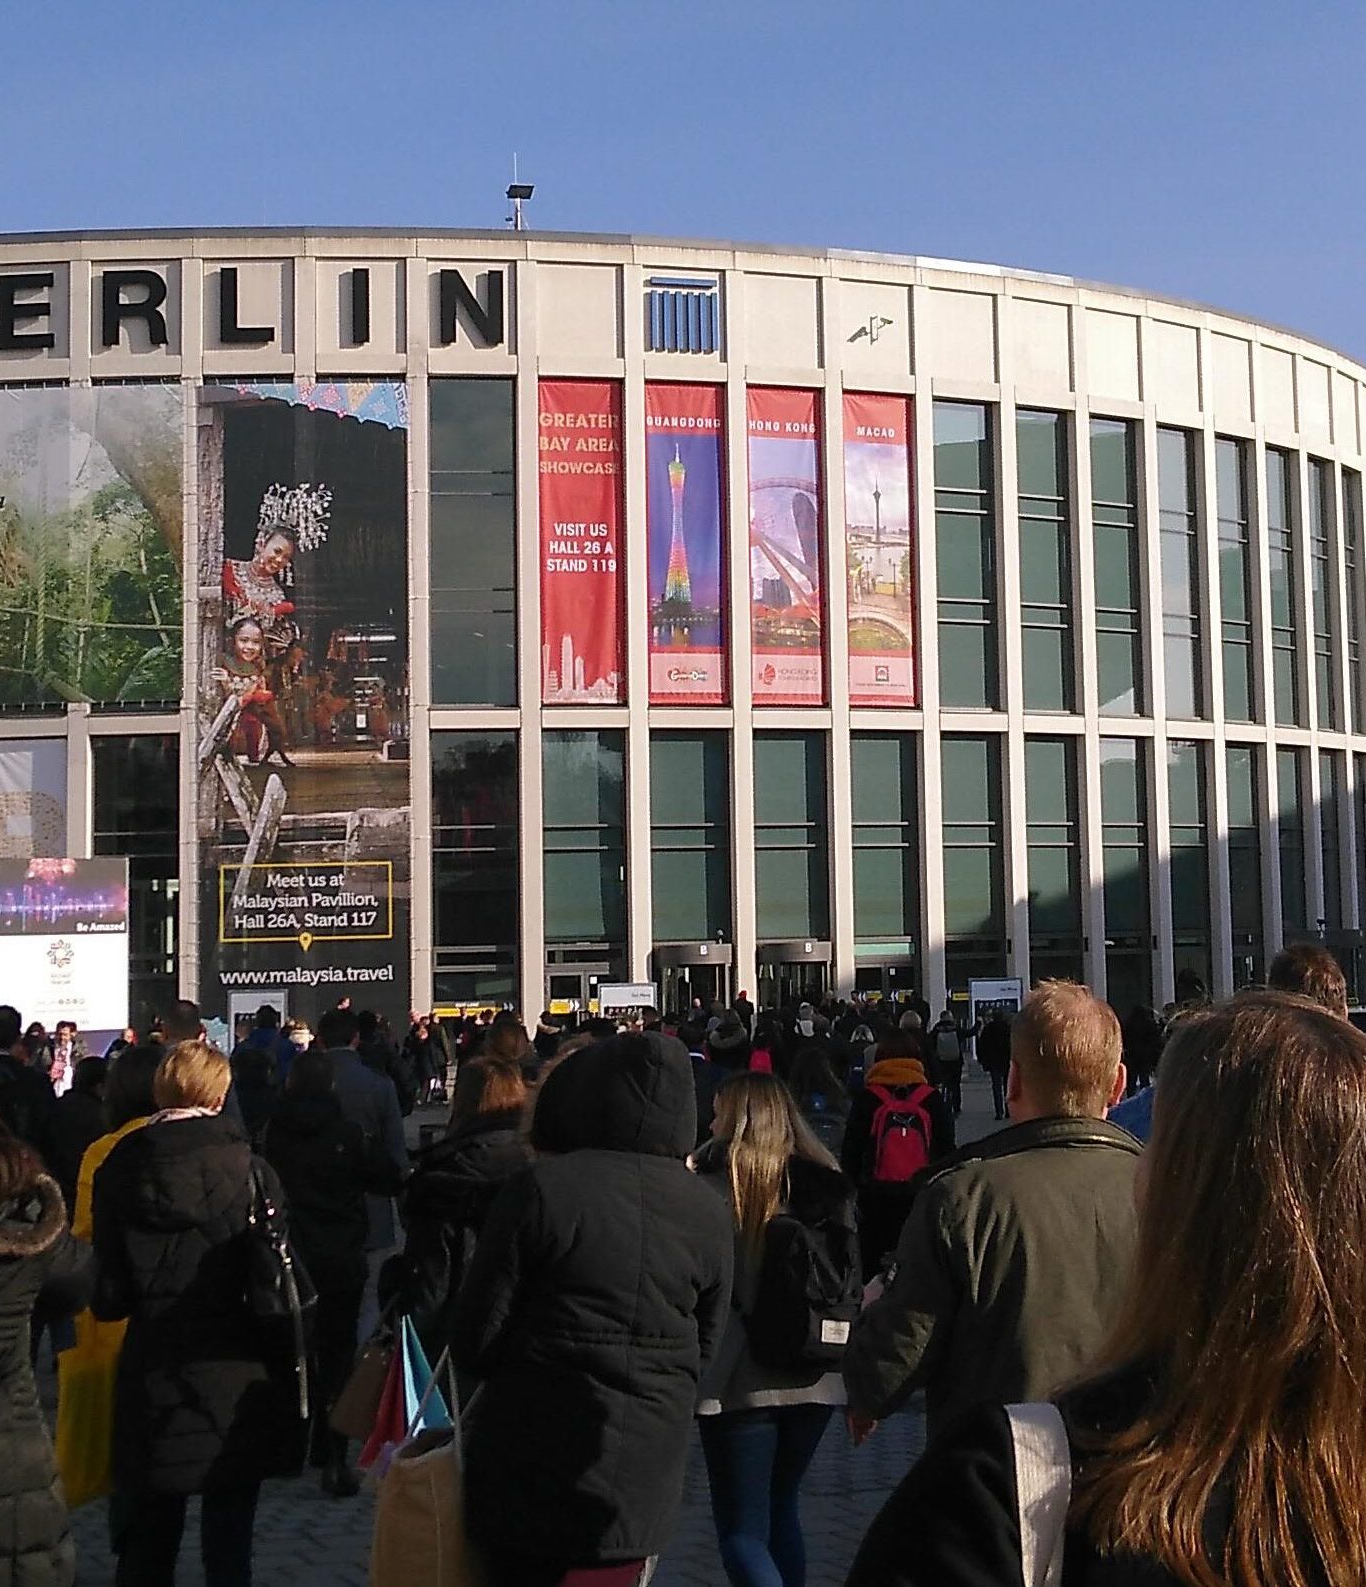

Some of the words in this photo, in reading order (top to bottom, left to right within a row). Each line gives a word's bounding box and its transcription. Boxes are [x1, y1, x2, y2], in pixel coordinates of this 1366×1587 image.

[539, 413, 619, 428] GREATER
[646, 415, 721, 428] GUANGDONG
[749, 420, 780, 431] HONG
[785, 421, 817, 433] KONG
[539, 437, 571, 451] BAY
[575, 438, 619, 452] AREA
[554, 523, 586, 537] VISIT
[590, 523, 608, 537] US
[549, 541, 581, 554] HALL
[584, 541, 601, 554] 26
[604, 541, 614, 554] A
[547, 559, 587, 572] STAND
[592, 559, 616, 572] 119
[267, 874, 305, 888] Meet
[307, 876, 326, 887] us
[329, 874, 344, 886] at
[233, 894, 308, 911] Malaysian
[312, 893, 379, 908] Pavillion,
[76, 923, 88, 932] Be
[89, 922, 126, 932] Amazed
[234, 915, 265, 929] Hall
[268, 914, 301, 929] 26A,
[305, 913, 347, 927] Stand
[351, 912, 377, 926] 117
[700, 945, 708, 956] B
[805, 942, 813, 953] B
[220, 965, 393, 986] www.malaysia.travel
